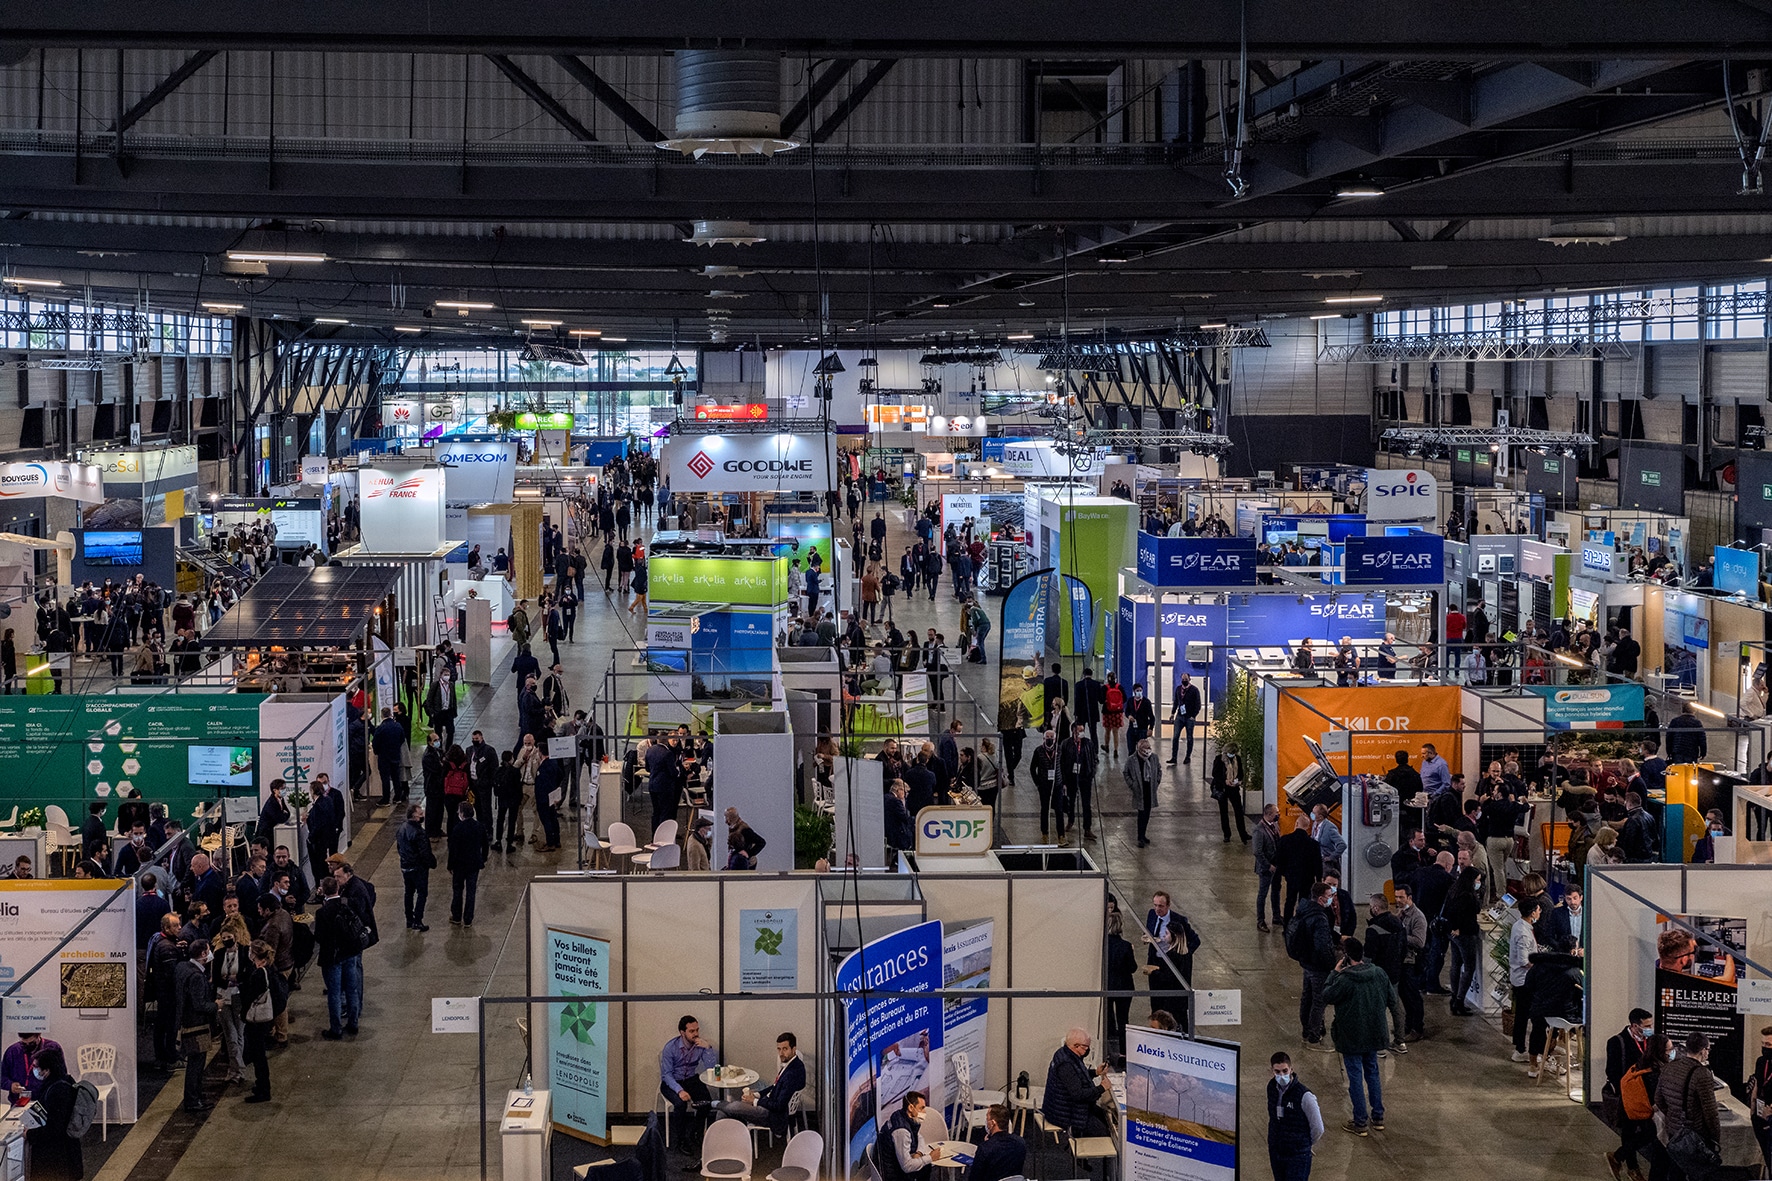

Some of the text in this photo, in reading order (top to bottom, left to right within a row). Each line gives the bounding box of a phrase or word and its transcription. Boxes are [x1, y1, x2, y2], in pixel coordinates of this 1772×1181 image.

[440, 453, 508, 463] OMEXOM
[723, 460, 812, 472] GOODWE
[1, 473, 39, 483] BOUYGUES
[389, 490, 417, 498] FRANCE
[1375, 484, 1430, 497] SPIE
[1170, 552, 1240, 569] SOFAR
[1362, 551, 1431, 568] SOFAR
[1310, 602, 1374, 618] SOFAR
[923, 820, 986, 839] GRDF
[0, 902, 19, 916] lia
[61, 951, 106, 959] archelios
[554, 938, 597, 956] Vos billets
[944, 944, 956, 954] lexis
[555, 951, 591, 965] n'auront
[555, 959, 598, 978] jamais été
[555, 973, 602, 990] aussi verts.
[1675, 989, 1738, 1003] ELEXPERT
[870, 1004, 906, 1029] des Bureaux
[862, 1023, 897, 1048] Costruction
[897, 1016, 904, 1027] et
[904, 1012, 914, 1024] du
[914, 1006, 929, 1019] BTP.
[1136, 1044, 1226, 1072] Alexis Assurances
[556, 1069, 600, 1088] LENDOPOLIS
[1135, 1118, 1154, 1129] Depuis
[1141, 1127, 1164, 1138] Courtier
[1164, 1133, 1199, 1147] d'Assurance
